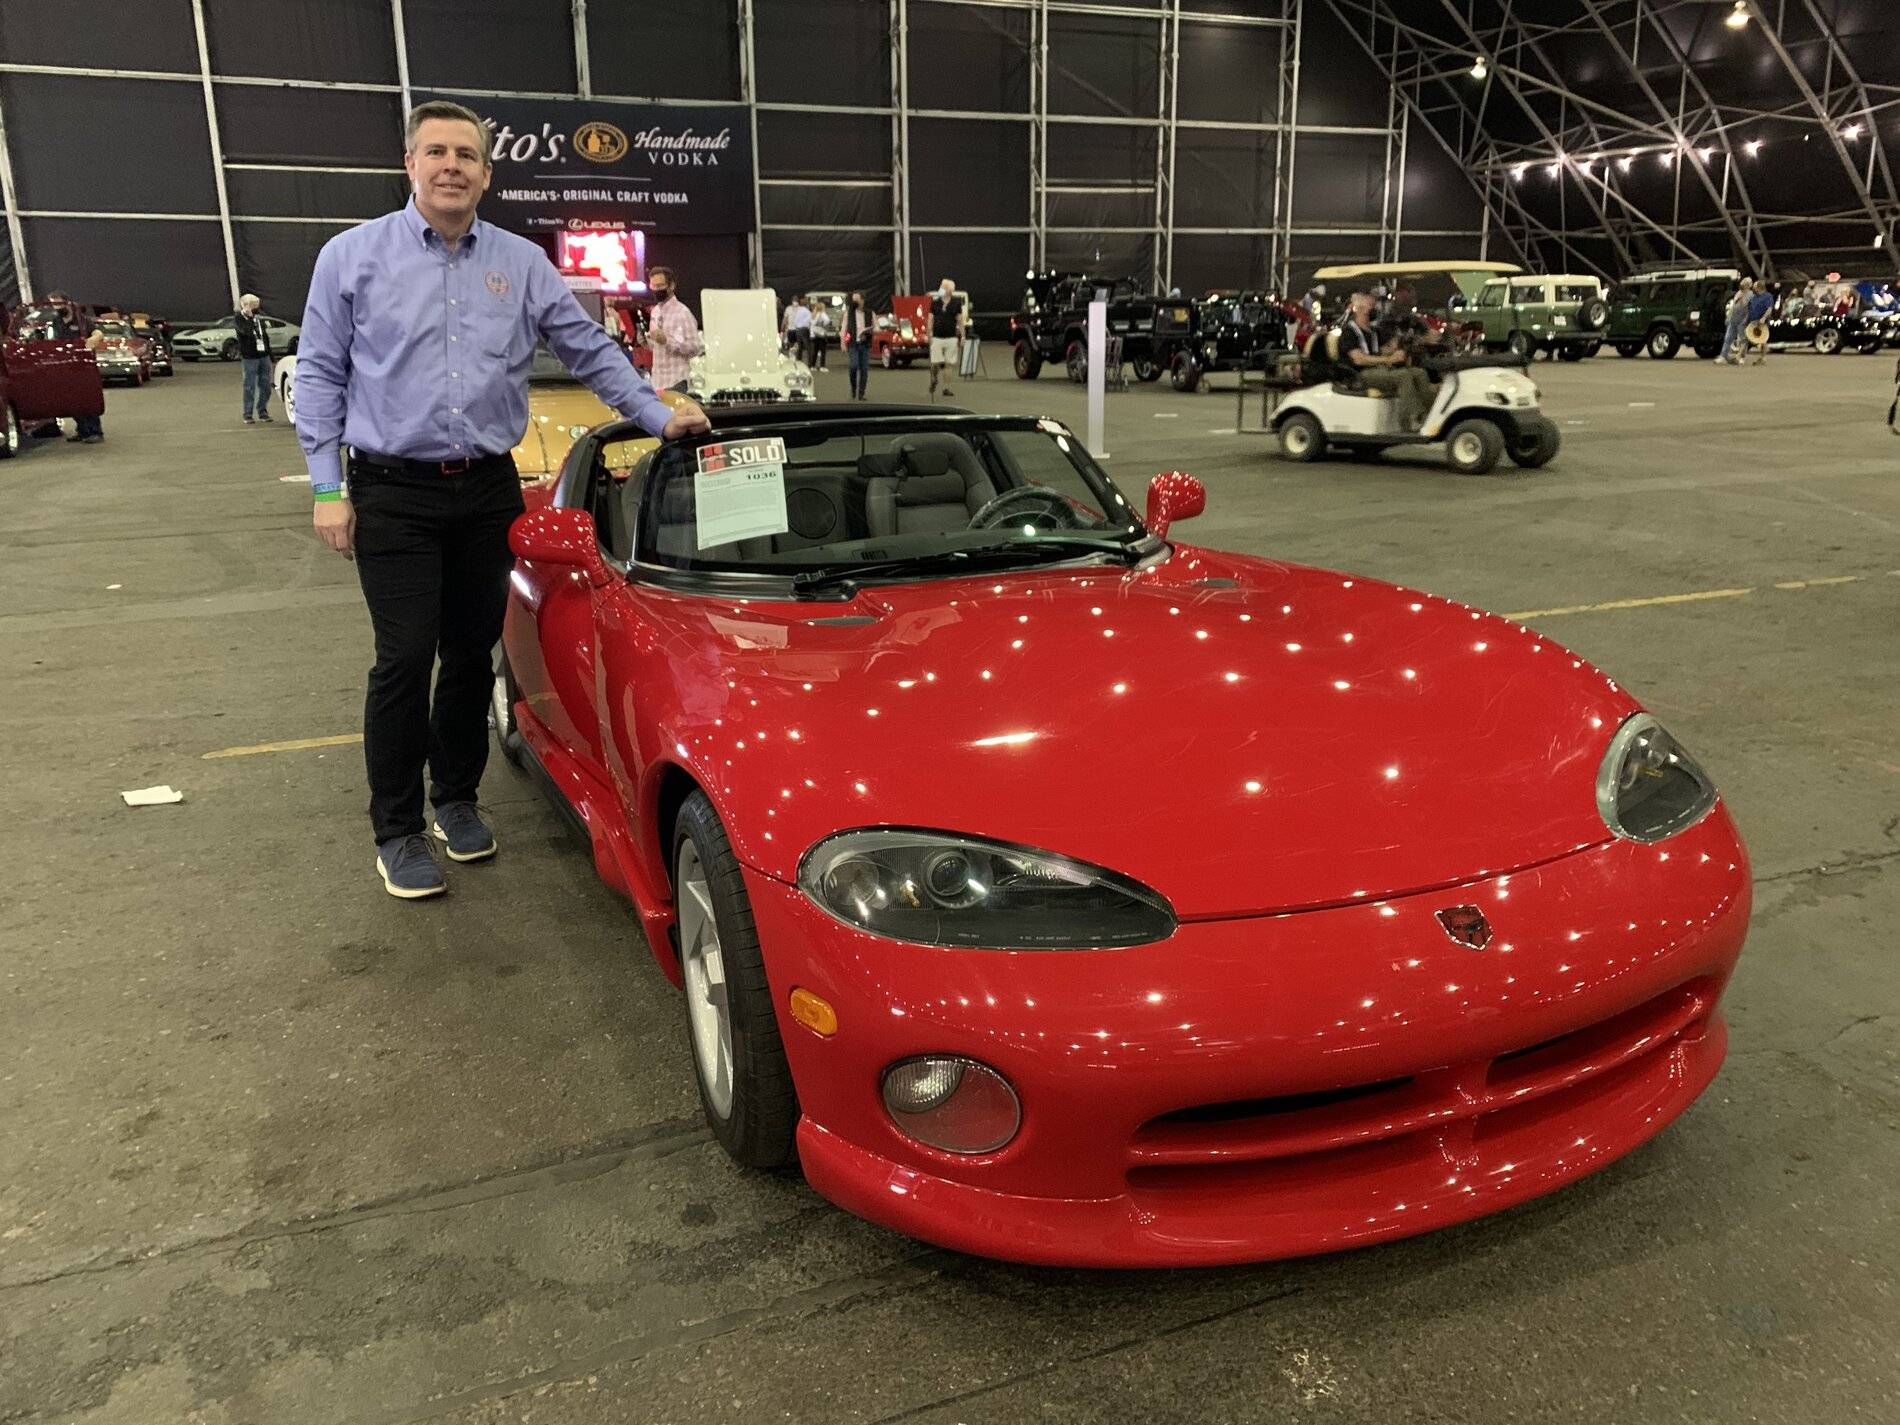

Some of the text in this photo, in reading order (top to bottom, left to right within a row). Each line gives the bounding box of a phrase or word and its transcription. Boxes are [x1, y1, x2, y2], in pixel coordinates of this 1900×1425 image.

[634, 126, 731, 150] Handmade
[648, 151, 719, 166] VODKA
[562, 189, 614, 201] ORIGINAL
[616, 190, 650, 203] CRAFT
[652, 192, 688, 204] VODKA
[583, 221, 626, 229] LEXUS
[729, 445, 780, 466] SOLD
